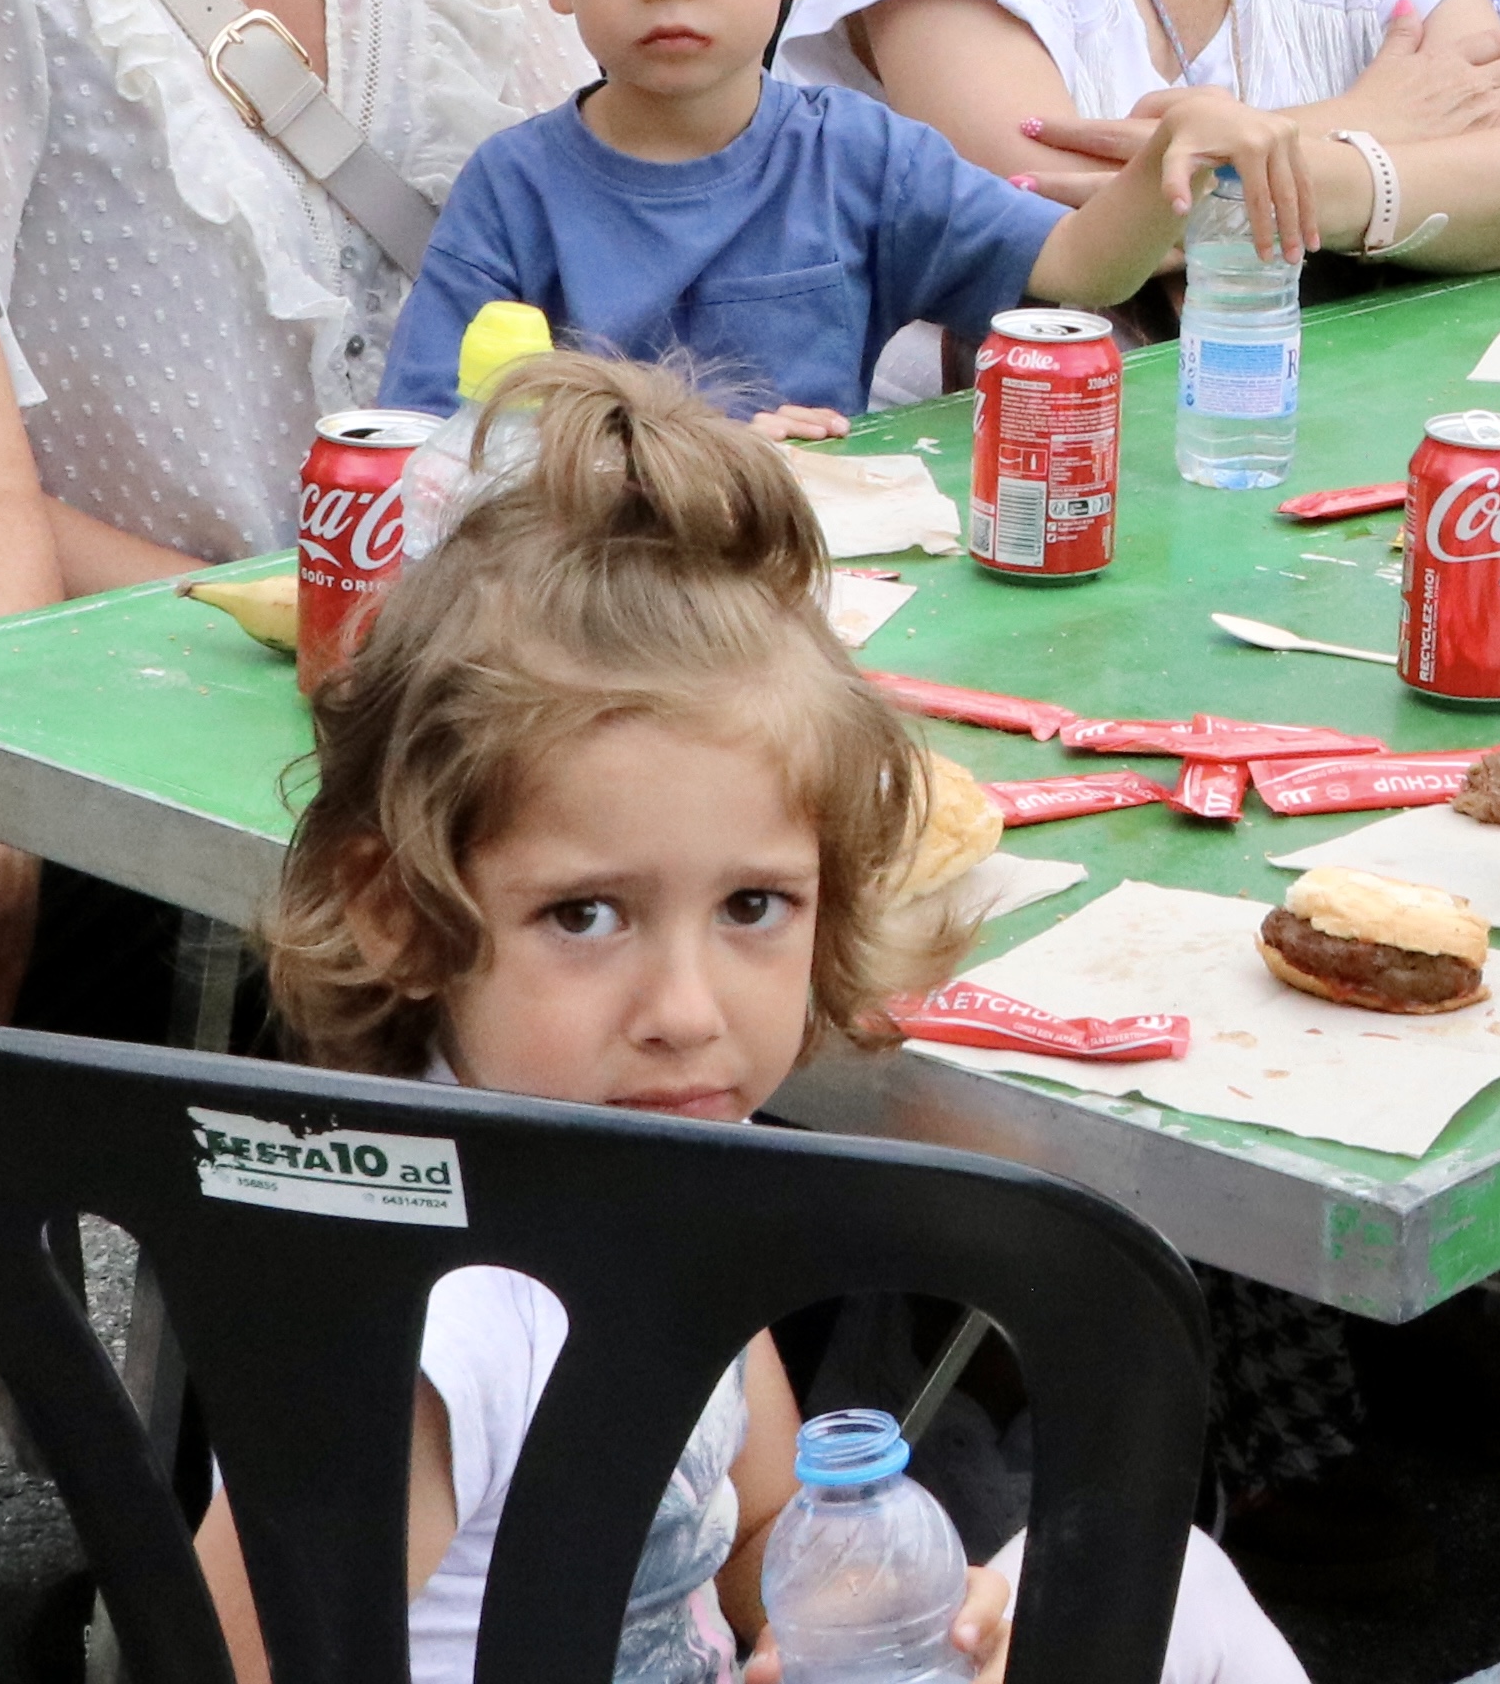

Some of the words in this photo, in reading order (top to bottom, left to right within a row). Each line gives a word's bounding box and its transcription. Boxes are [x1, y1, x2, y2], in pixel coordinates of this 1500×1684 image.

[300, 566, 336, 588] GOÛT
[1418, 567, 1436, 683] RECYCLEZ-MOI
[1373, 769, 1470, 794] ETCHUP
[400, 1162, 451, 1185] ad
